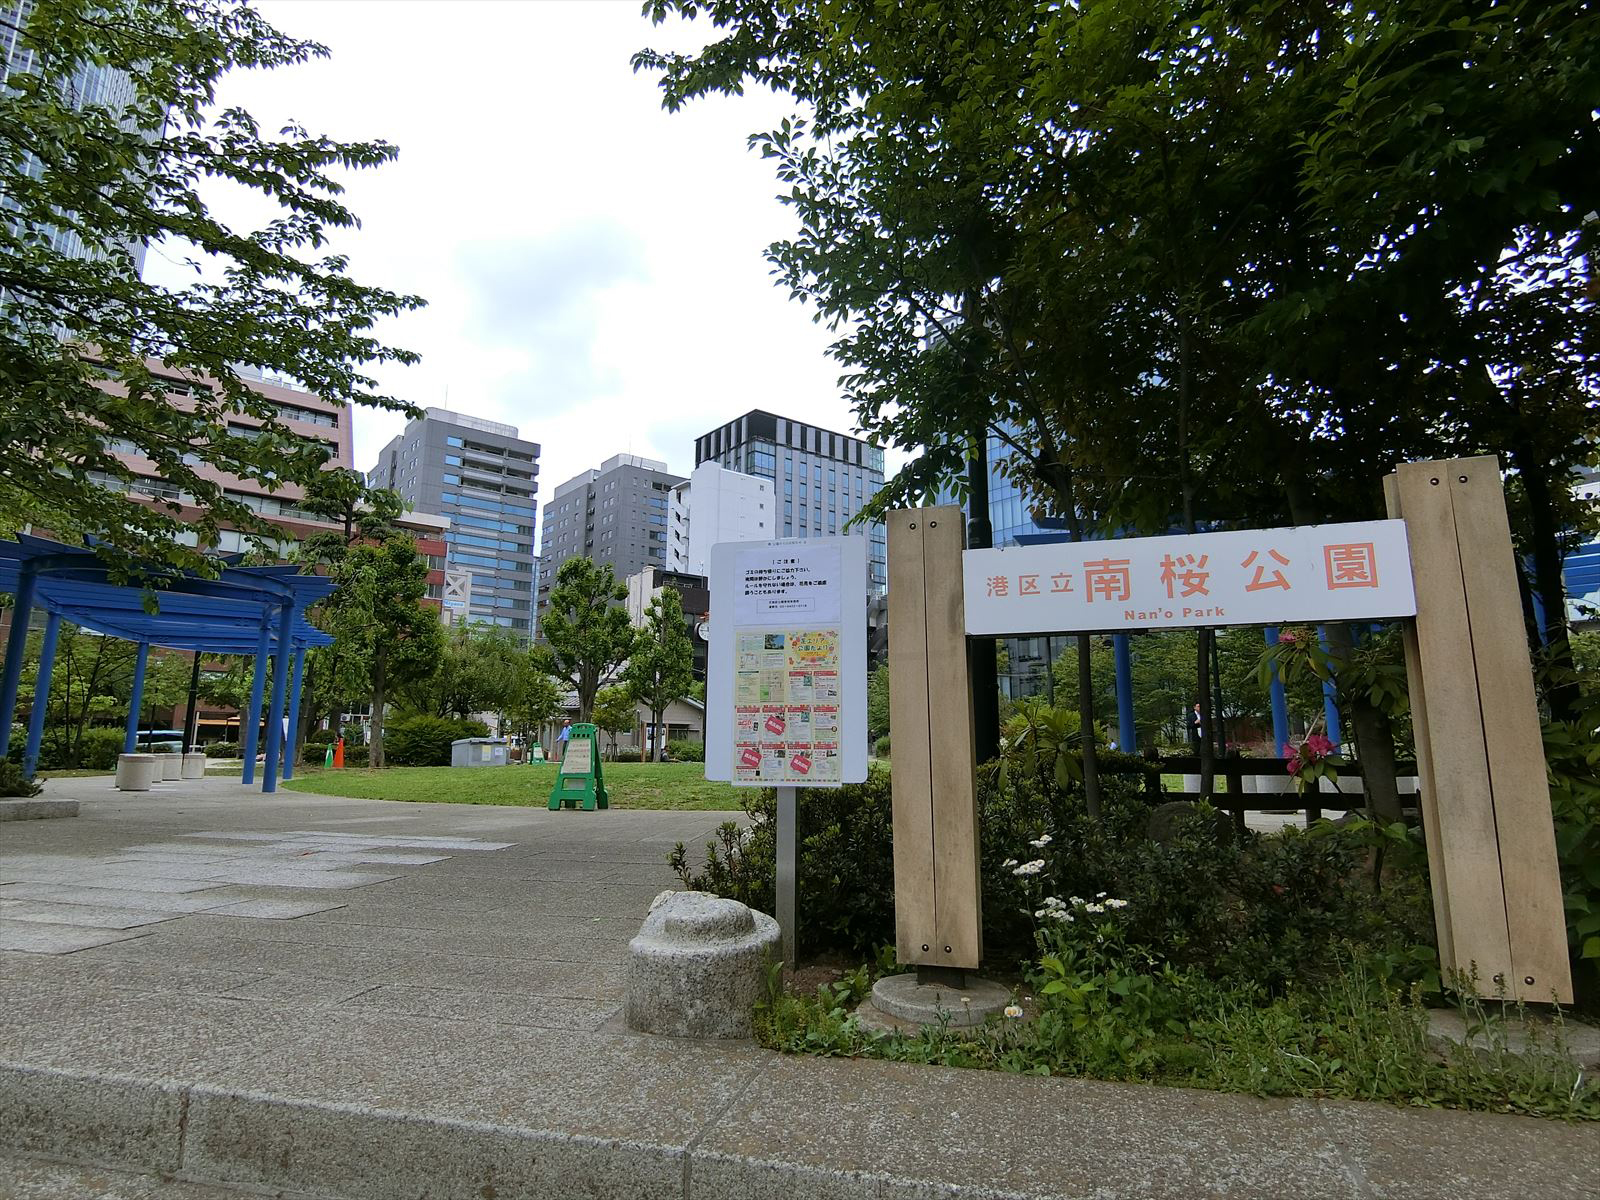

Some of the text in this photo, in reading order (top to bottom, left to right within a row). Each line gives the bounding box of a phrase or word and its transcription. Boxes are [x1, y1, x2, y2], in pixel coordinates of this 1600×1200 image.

[986, 542, 1378, 603] 港区立 南桜公園
[1182, 606, 1225, 618] Park
